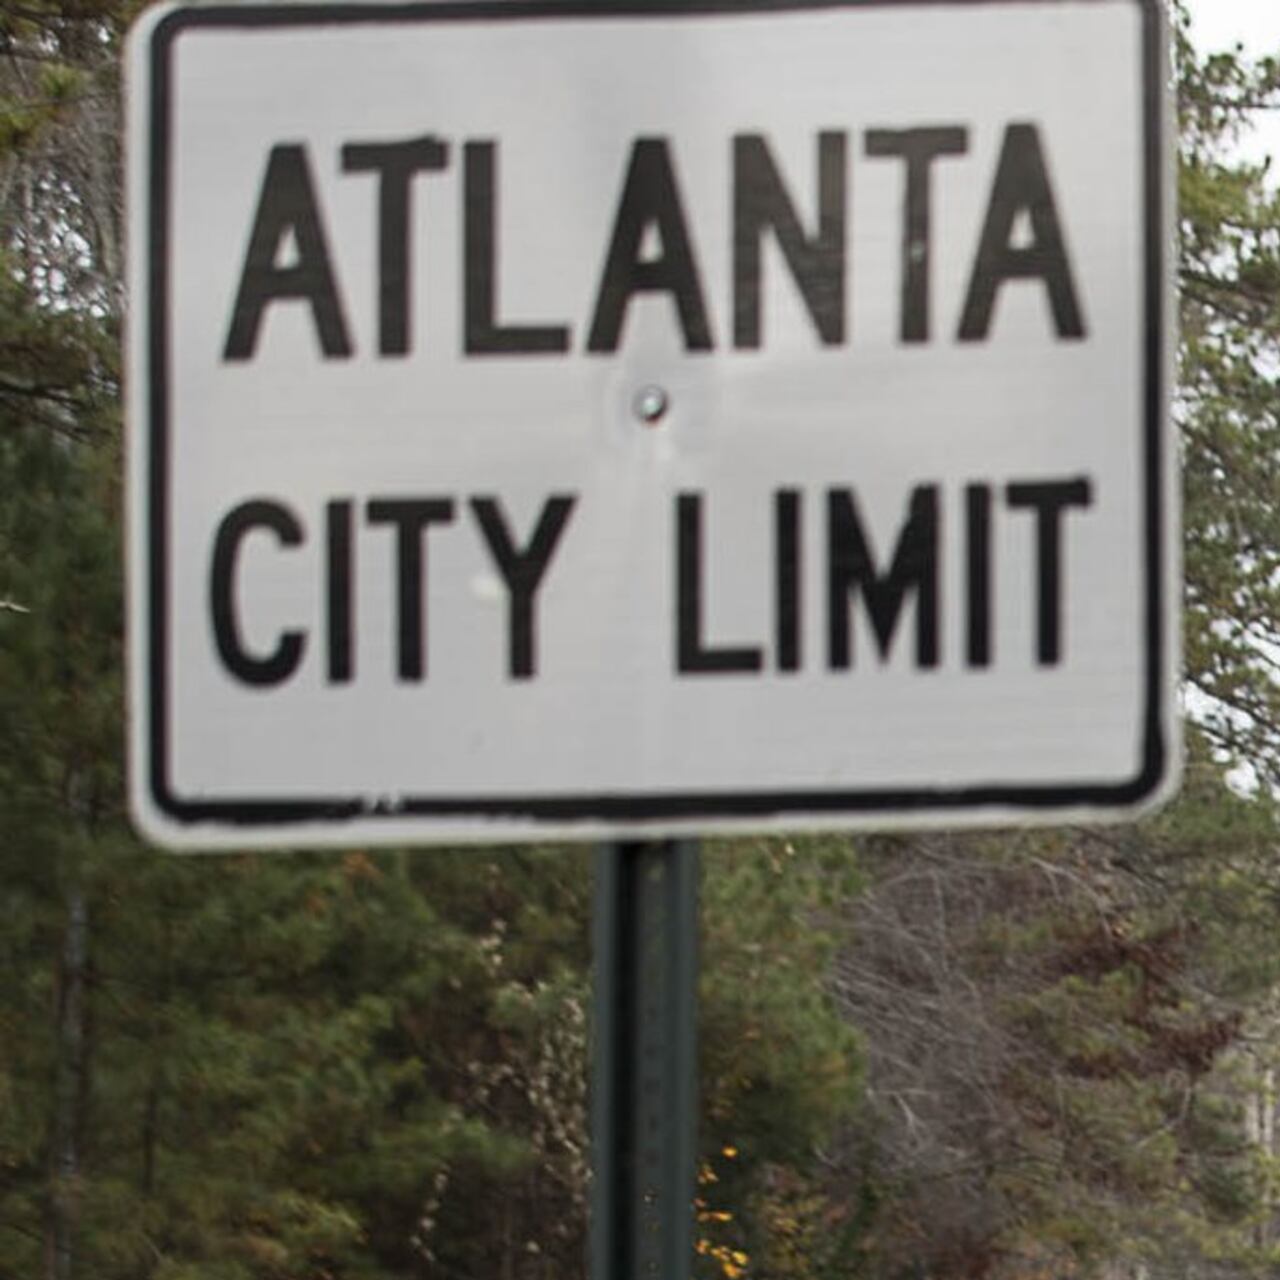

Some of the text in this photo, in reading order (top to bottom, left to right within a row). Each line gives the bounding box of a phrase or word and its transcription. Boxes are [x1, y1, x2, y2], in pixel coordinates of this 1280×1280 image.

[221, 122, 1089, 361] ATLANTA
[207, 477, 1093, 689] CITY LIMIT
